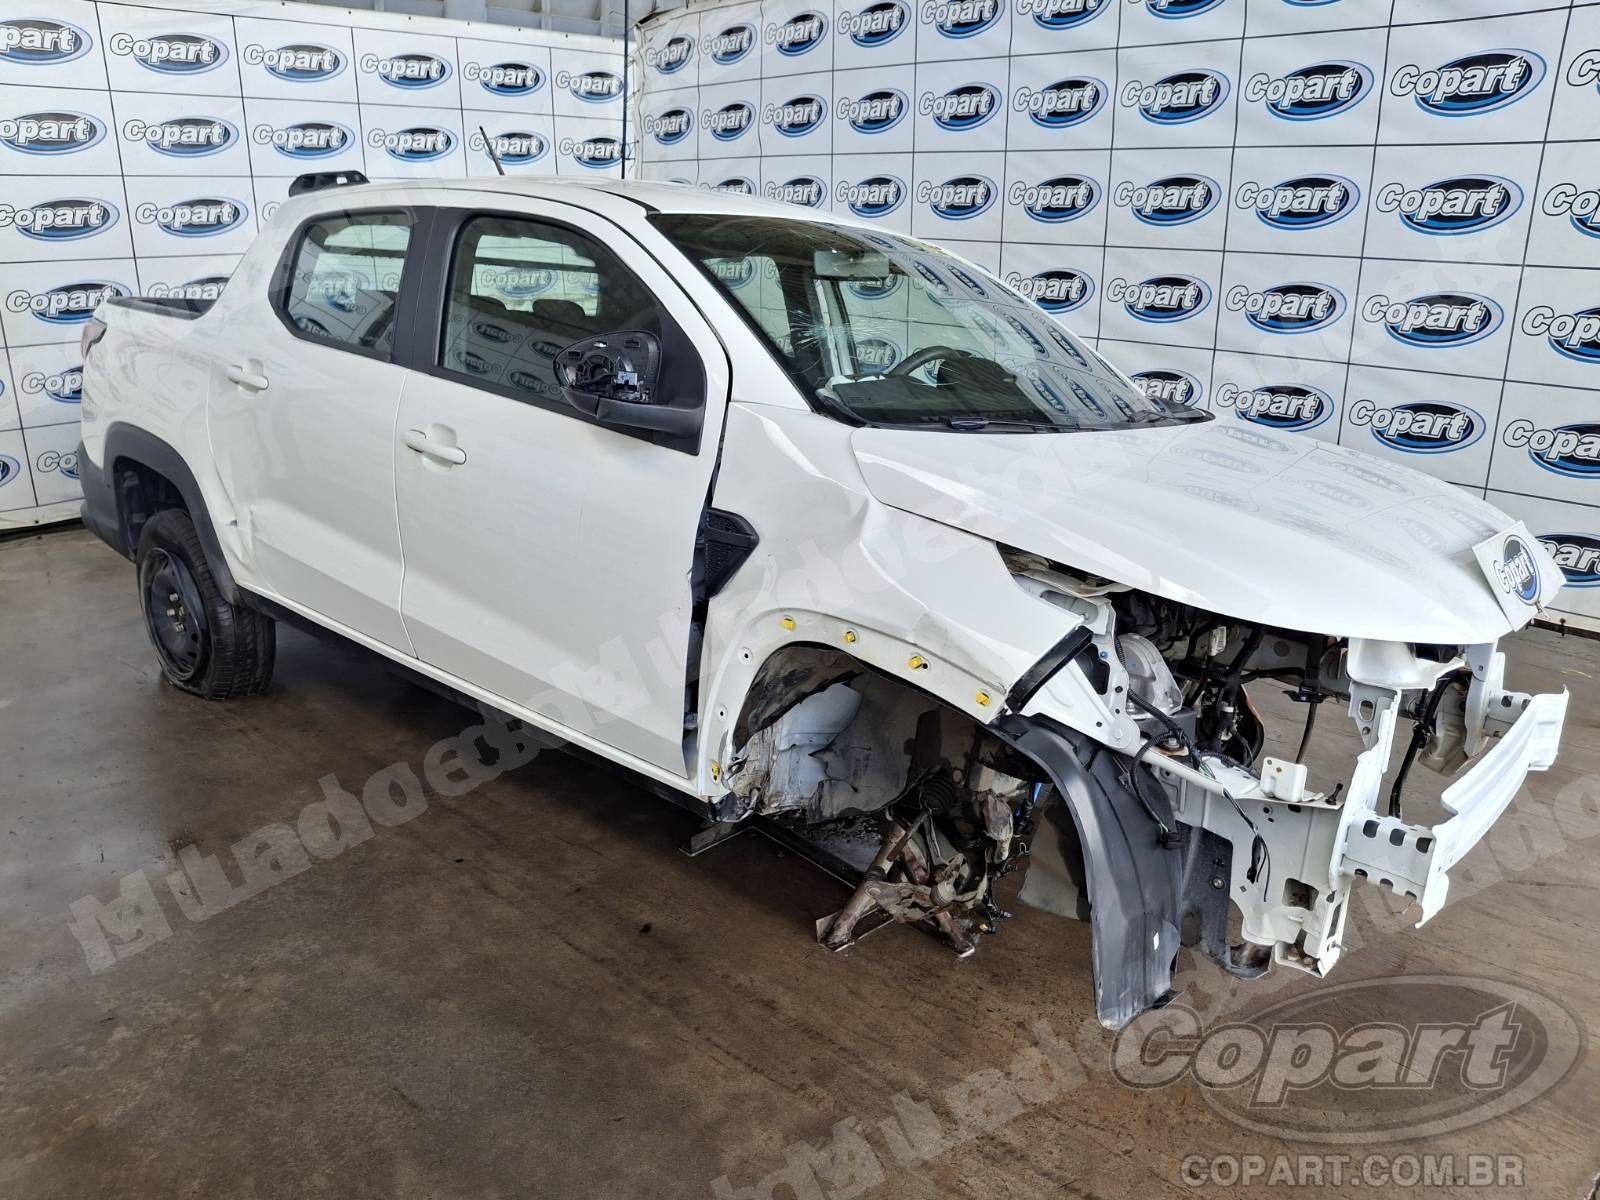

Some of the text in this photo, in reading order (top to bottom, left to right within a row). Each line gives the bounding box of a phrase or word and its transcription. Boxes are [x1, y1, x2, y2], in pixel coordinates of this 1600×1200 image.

[837, 4, 903, 38] Copart
[921, 0, 996, 31] Copart
[0, 27, 75, 52] part
[701, 27, 751, 60] Copart
[765, 16, 822, 48] Copart
[110, 33, 216, 63] Copart
[244, 44, 336, 72] Copart
[361, 53, 444, 81] Copart
[464, 61, 536, 89] Copart
[1391, 55, 1529, 104] Copart
[556, 71, 621, 95] Copart
[1122, 75, 1219, 115] Copart
[1245, 68, 1356, 110] Copart
[763, 96, 821, 128] Copart
[836, 89, 903, 124] Copart
[919, 88, 993, 120] Copart
[1012, 81, 1098, 117] Copart
[0, 117, 91, 145] opart
[644, 109, 690, 138] Copart
[701, 102, 751, 132] Copart
[123, 118, 225, 151] Copart
[253, 124, 344, 150] Copart
[367, 128, 447, 154] Copart
[559, 138, 623, 162] Copart
[764, 180, 821, 200] Copart
[835, 180, 901, 210] Copart
[917, 180, 989, 209] Copart
[1008, 181, 1092, 211] Copart
[1114, 181, 1213, 215] Copart
[1235, 181, 1346, 217] Copart
[1376, 182, 1505, 222] Copart
[0, 203, 103, 232] Copart
[136, 202, 236, 229] Copart
[481, 268, 547, 291] Copart
[1005, 271, 1084, 302] Copart
[1106, 278, 1203, 310] Copart
[1225, 285, 1333, 320] Copart
[1362, 294, 1487, 332] Copart
[1522, 305, 1600, 348] Cop
[22, 371, 83, 397] Cop
[1133, 377, 1193, 404] part
[1216, 383, 1323, 421] Copart
[1348, 399, 1471, 441] Copart
[1503, 418, 1600, 461] Copa
